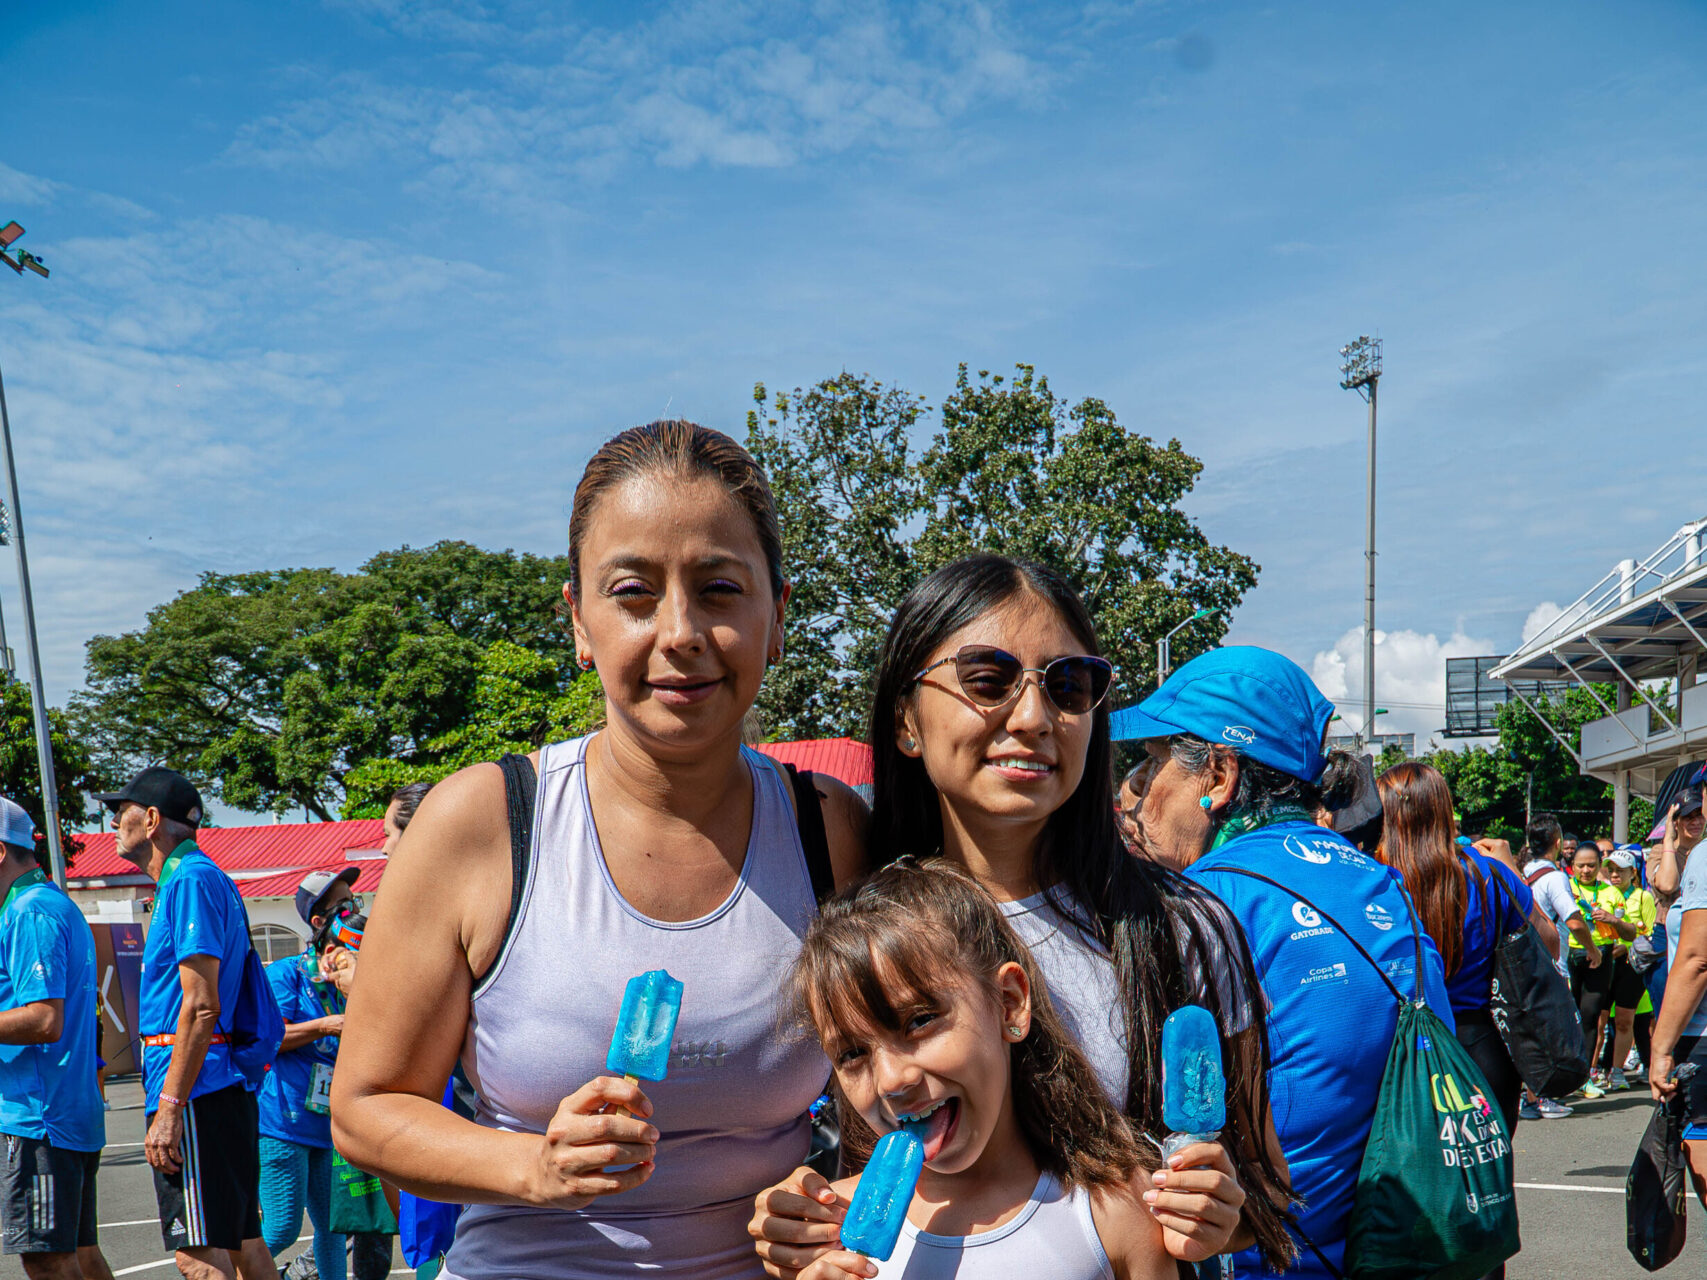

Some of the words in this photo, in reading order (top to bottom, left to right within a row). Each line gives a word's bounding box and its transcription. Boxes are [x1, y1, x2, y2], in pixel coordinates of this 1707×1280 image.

[1225, 726, 1253, 744] TENA
[1290, 927, 1334, 941] GATORADE
[1309, 966, 1333, 976] Copa
[1300, 973, 1334, 985] Airlines
[1475, 1138, 1510, 1164] ESTA
